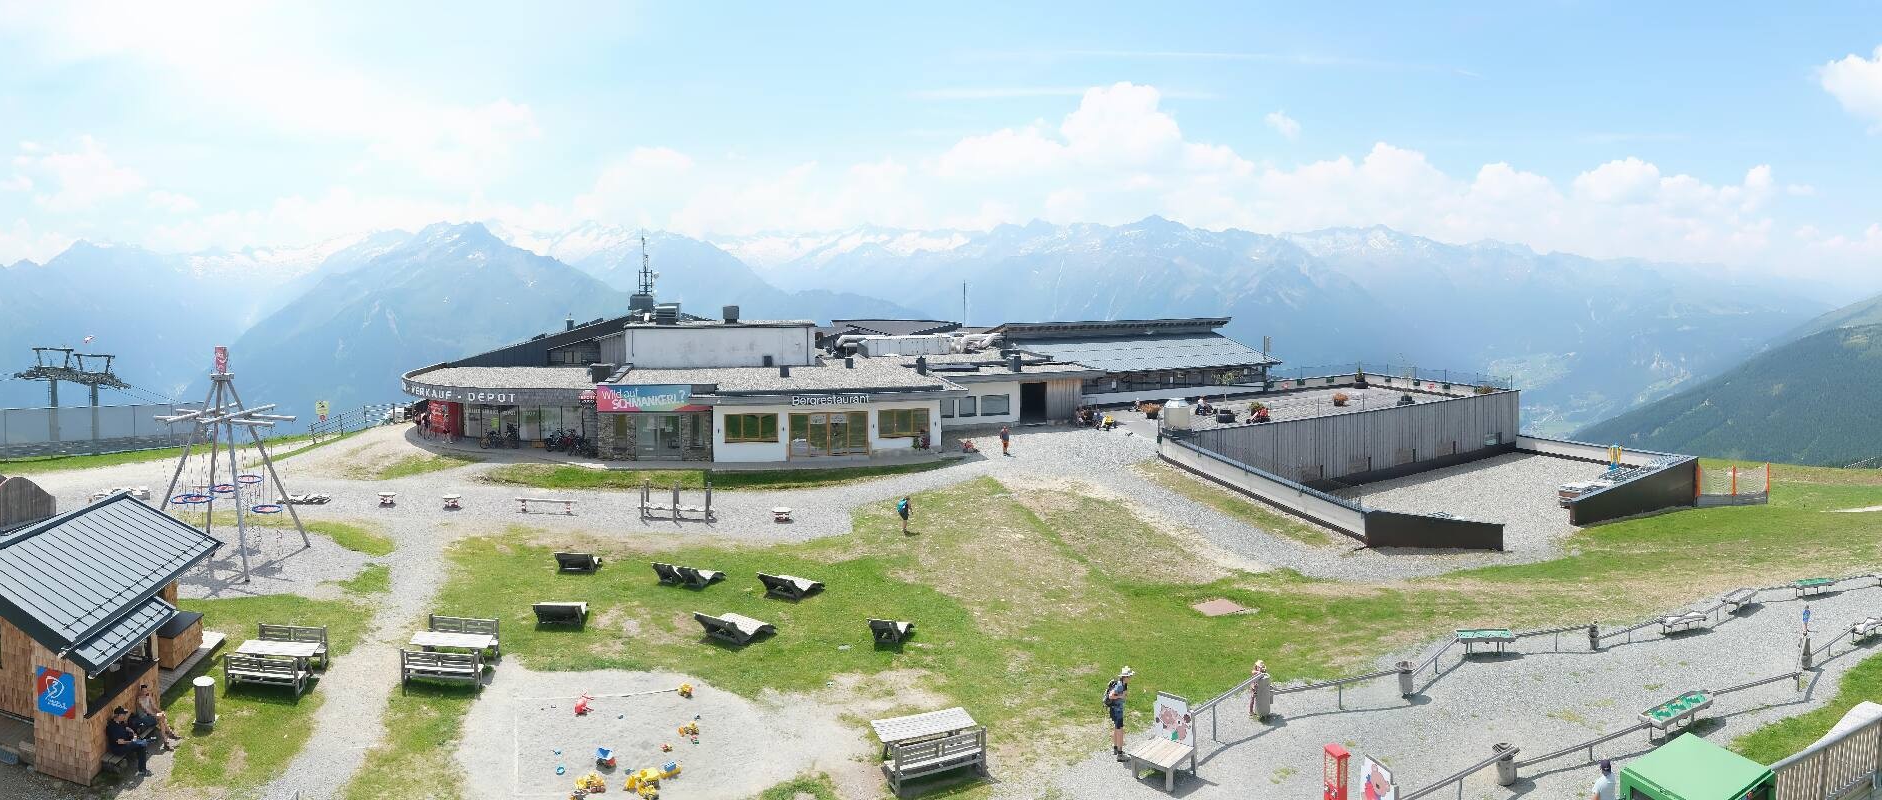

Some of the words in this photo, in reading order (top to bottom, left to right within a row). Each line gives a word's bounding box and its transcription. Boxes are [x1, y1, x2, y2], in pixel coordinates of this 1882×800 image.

[411, 386, 452, 400] VERKAUF
[468, 392, 516, 403] DEPOT
[601, 388, 622, 400] Wild
[623, 387, 639, 399] auf
[792, 394, 869, 406] Bergrestaurant
